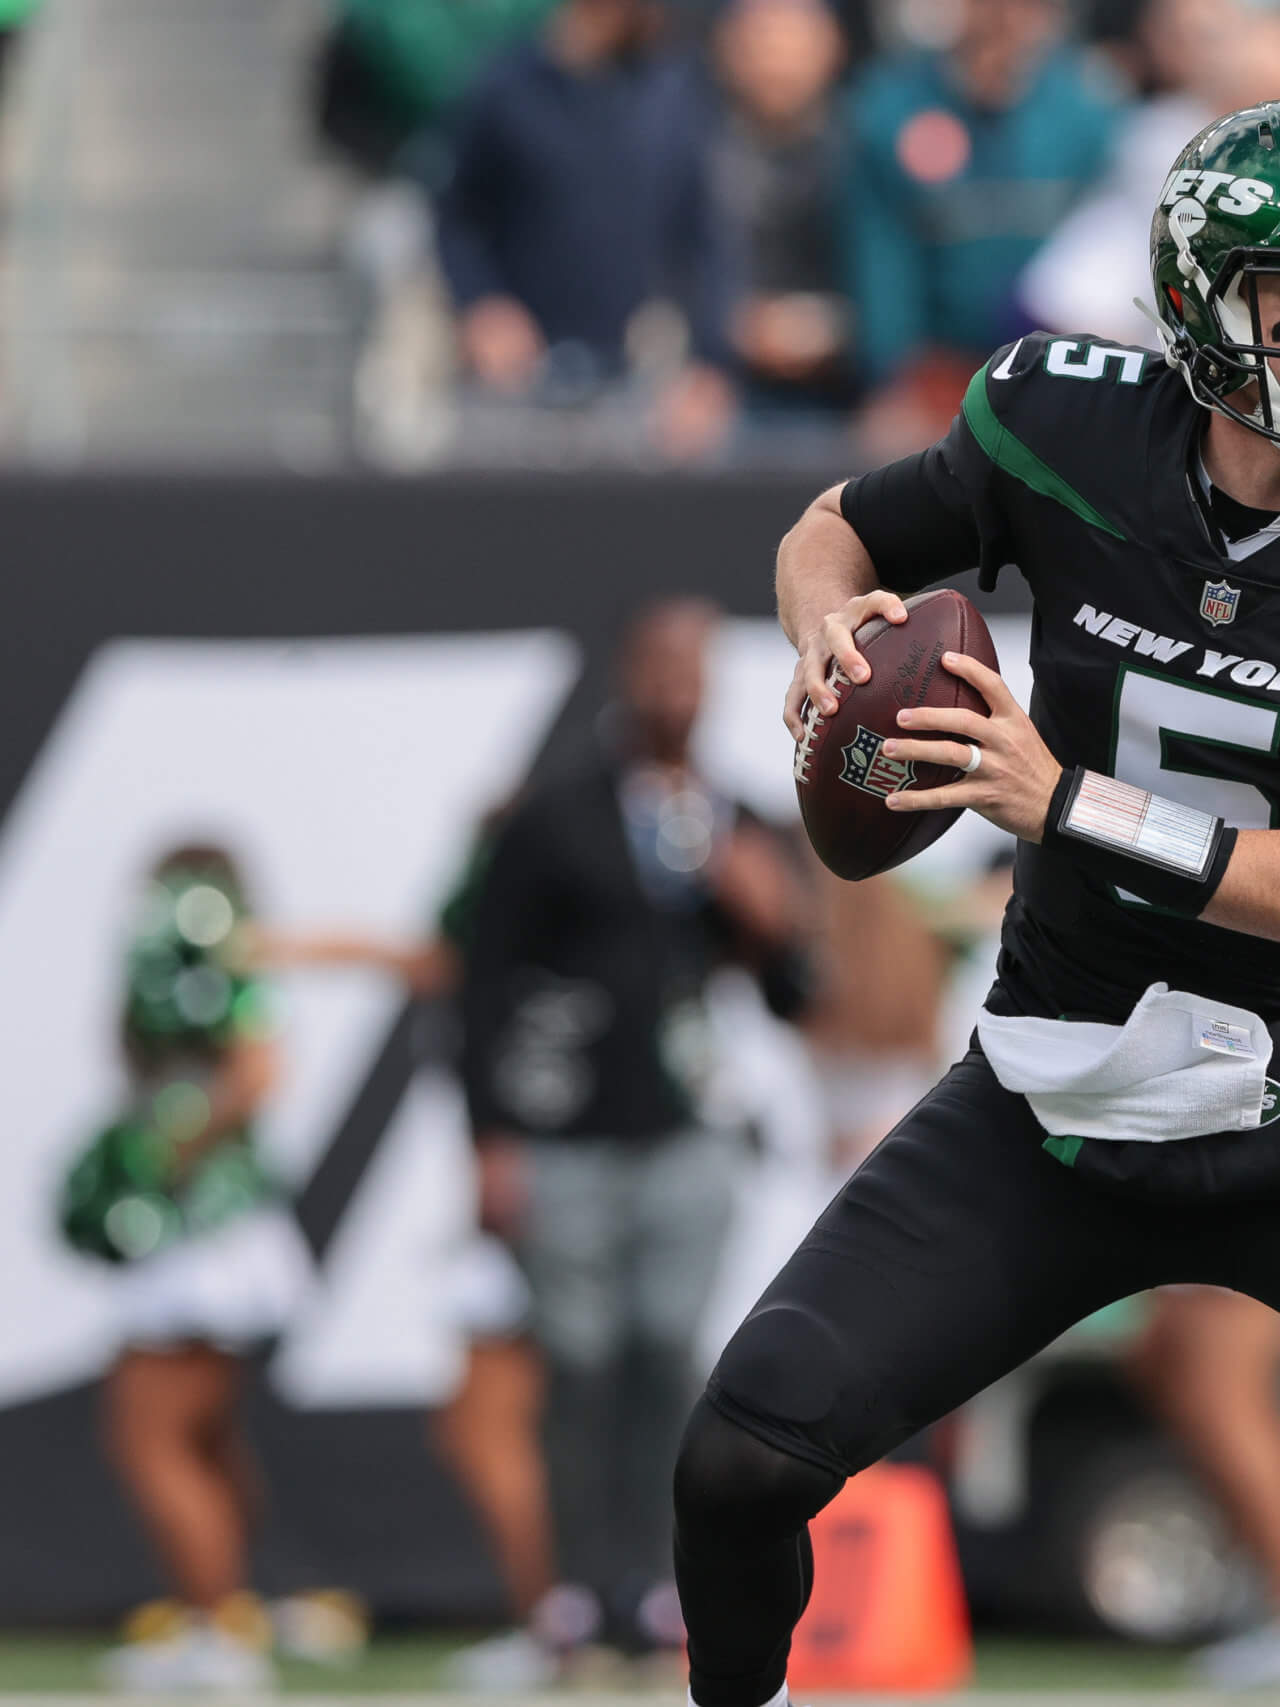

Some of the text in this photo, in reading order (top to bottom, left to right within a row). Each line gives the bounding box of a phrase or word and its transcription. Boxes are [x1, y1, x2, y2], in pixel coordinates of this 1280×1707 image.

[1161, 170, 1274, 216] ETS
[1043, 338, 1147, 385] 5
[1206, 599, 1230, 619] NFL
[1073, 603, 1194, 664] NEW
